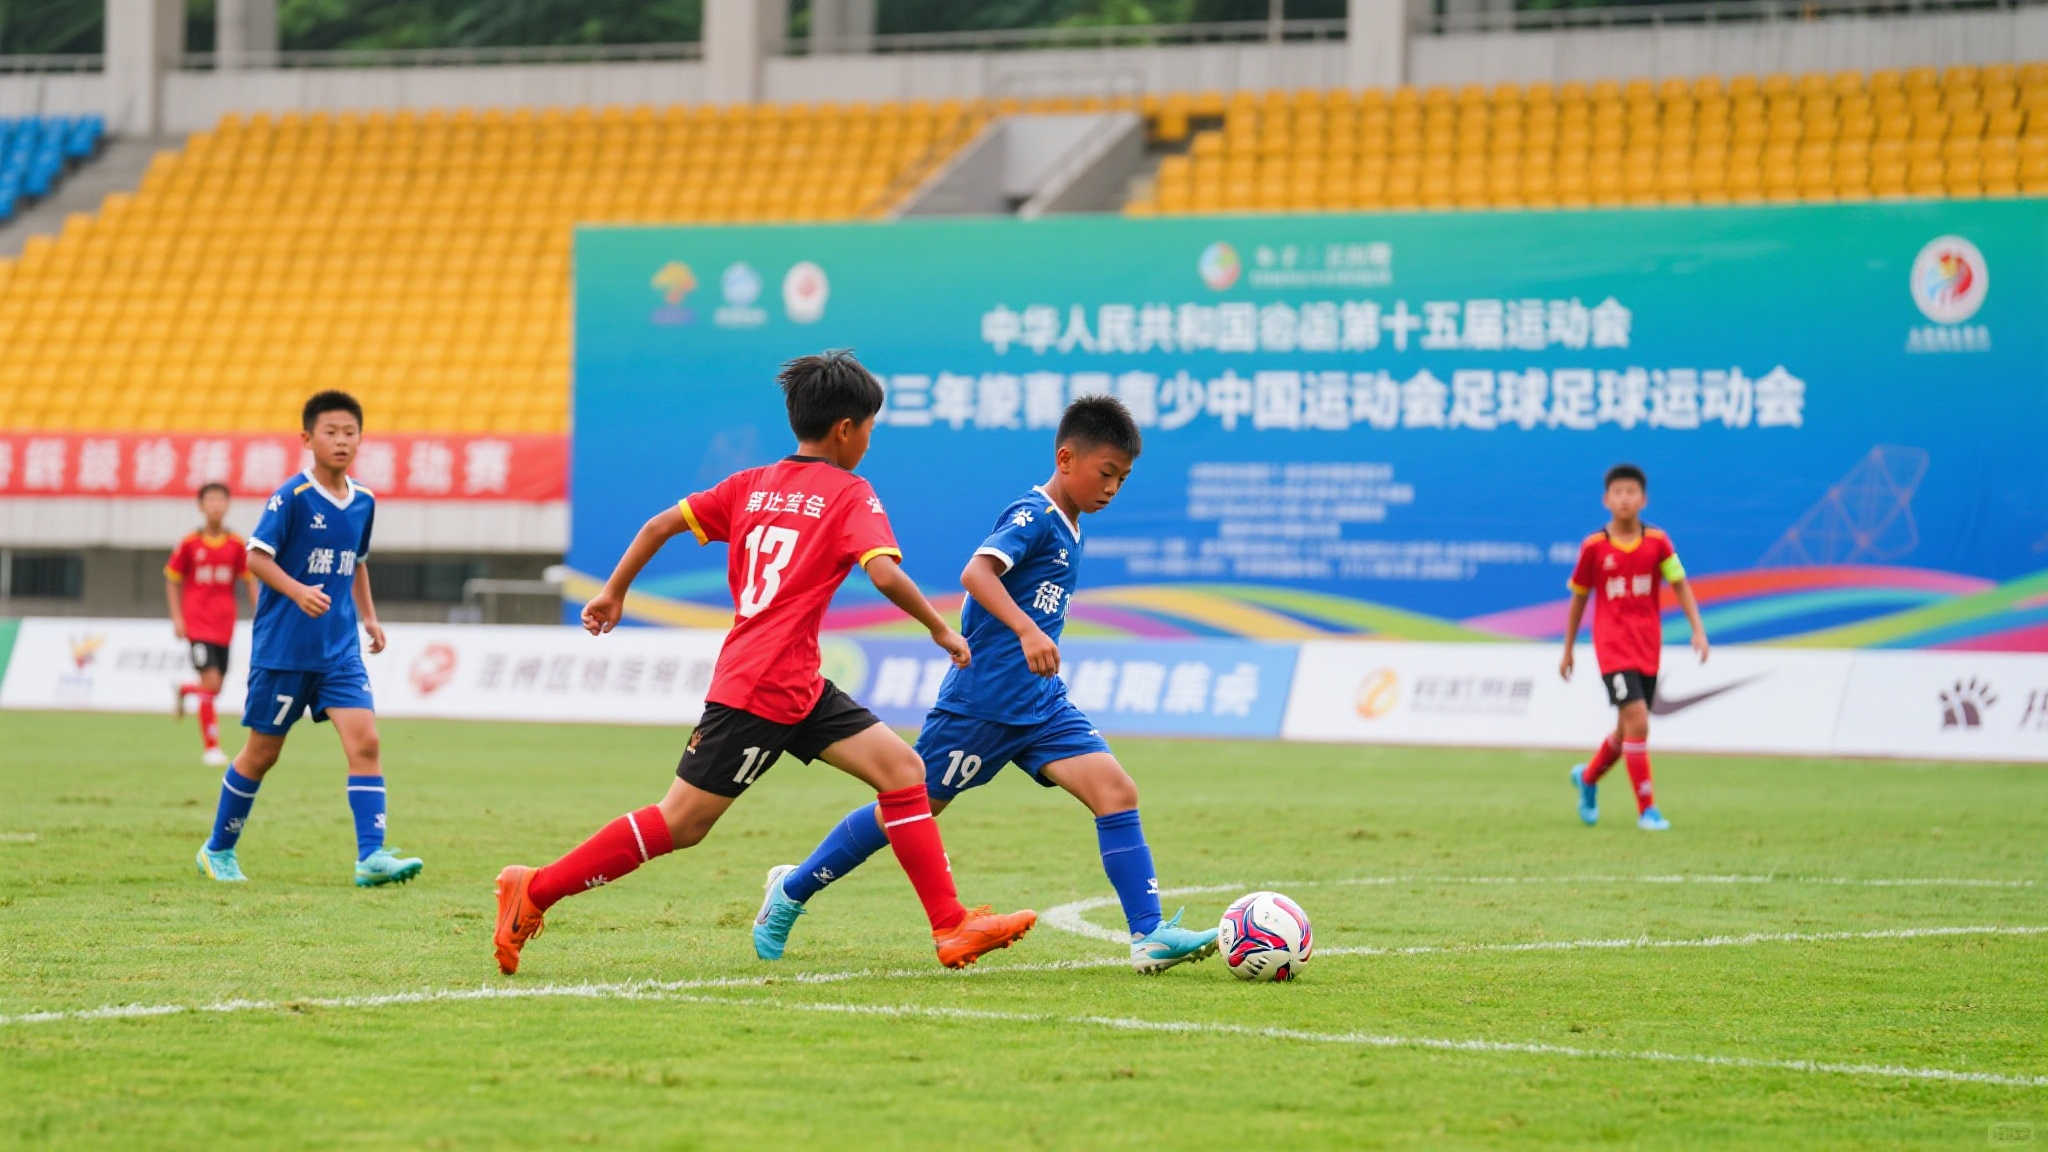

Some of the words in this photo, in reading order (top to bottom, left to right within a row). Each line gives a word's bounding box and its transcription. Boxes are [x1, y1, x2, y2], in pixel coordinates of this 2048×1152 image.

[739, 524, 800, 619] 13
[272, 694, 294, 726] 7
[941, 750, 982, 788] 19
